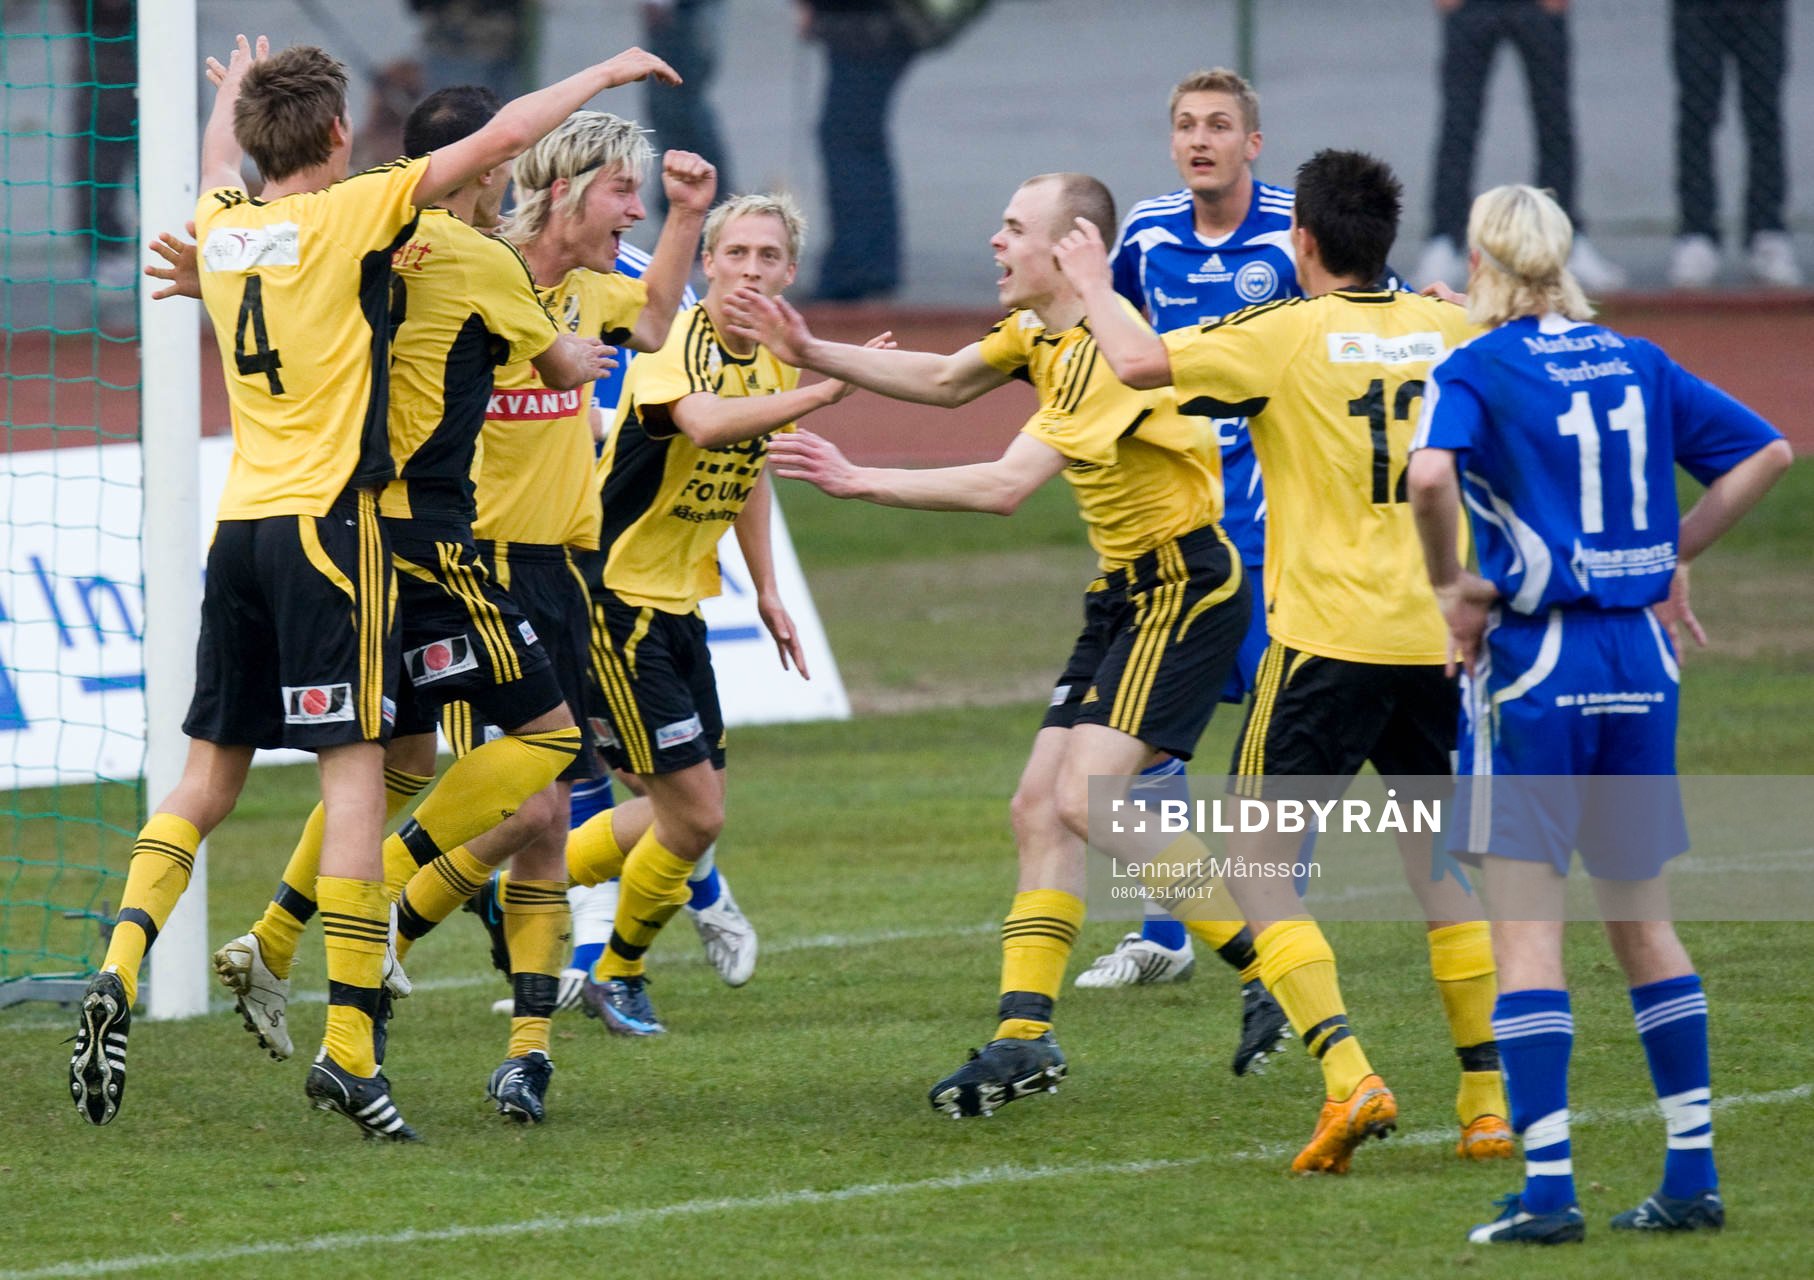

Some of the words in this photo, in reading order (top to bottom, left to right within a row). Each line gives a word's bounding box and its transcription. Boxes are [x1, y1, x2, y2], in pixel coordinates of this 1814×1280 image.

[235, 274, 285, 395] 4
[681, 478, 753, 503] FOUM
[1556, 385, 1648, 533] 11
